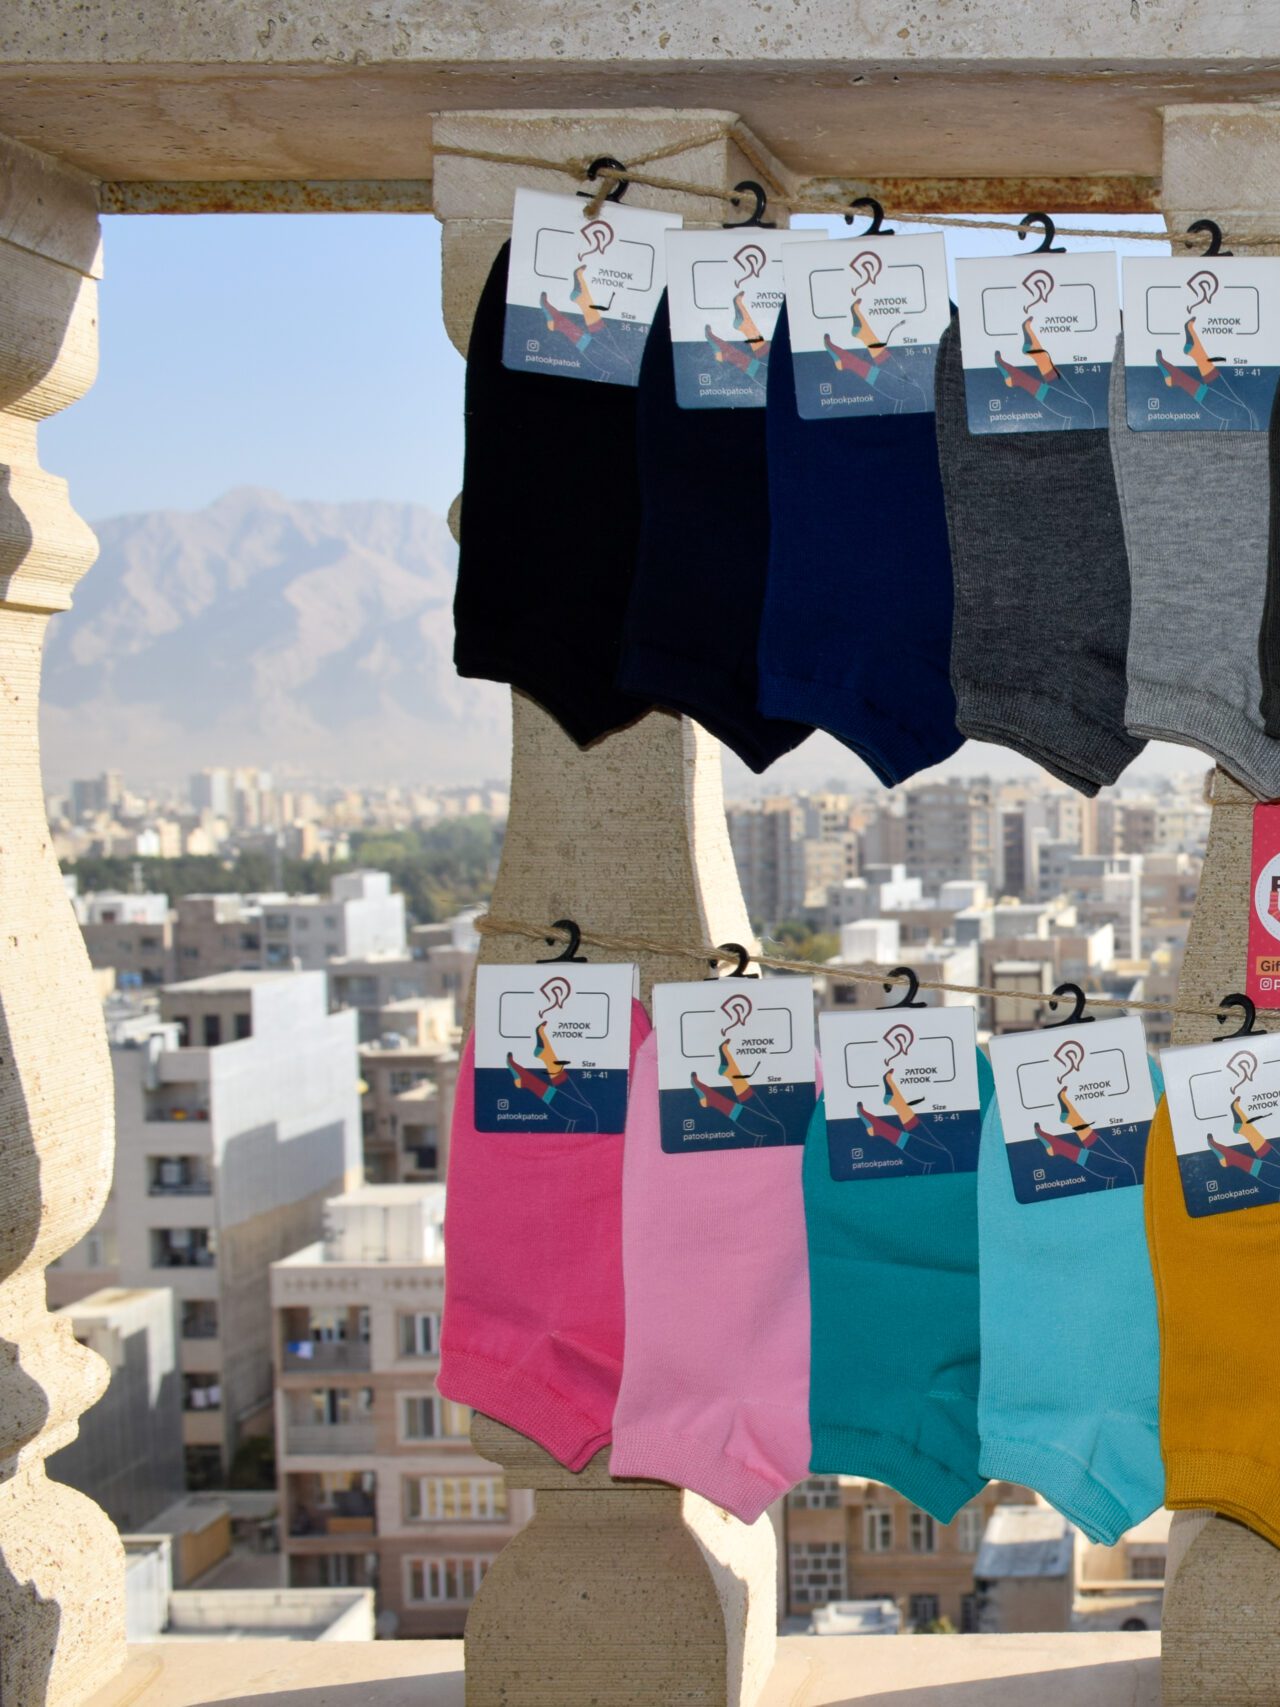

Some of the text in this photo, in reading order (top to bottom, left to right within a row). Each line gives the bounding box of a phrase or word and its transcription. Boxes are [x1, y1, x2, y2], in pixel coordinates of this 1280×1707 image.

[599, 268, 633, 280] PATOOK
[591, 277, 624, 288] PATOOK
[874, 297, 907, 306] PATOOK
[868, 307, 900, 316] PATOOK
[525, 354, 580, 368] patookpatook
[821, 395, 874, 405] patookpatook
[989, 412, 1042, 422] patookpatook
[905, 1067, 938, 1075] PATOOK
[900, 1076, 930, 1084] PATOOK
[1079, 1081, 1111, 1091] PATOOK
[1075, 1091, 1105, 1101] PATOOK
[1248, 1101, 1278, 1111] PATOOK
[683, 1132, 736, 1141] patookpatook
[852, 1159, 903, 1170] patookpatook
[1035, 1176, 1086, 1191] patookpatook
[1209, 1187, 1259, 1203] patookpatook
